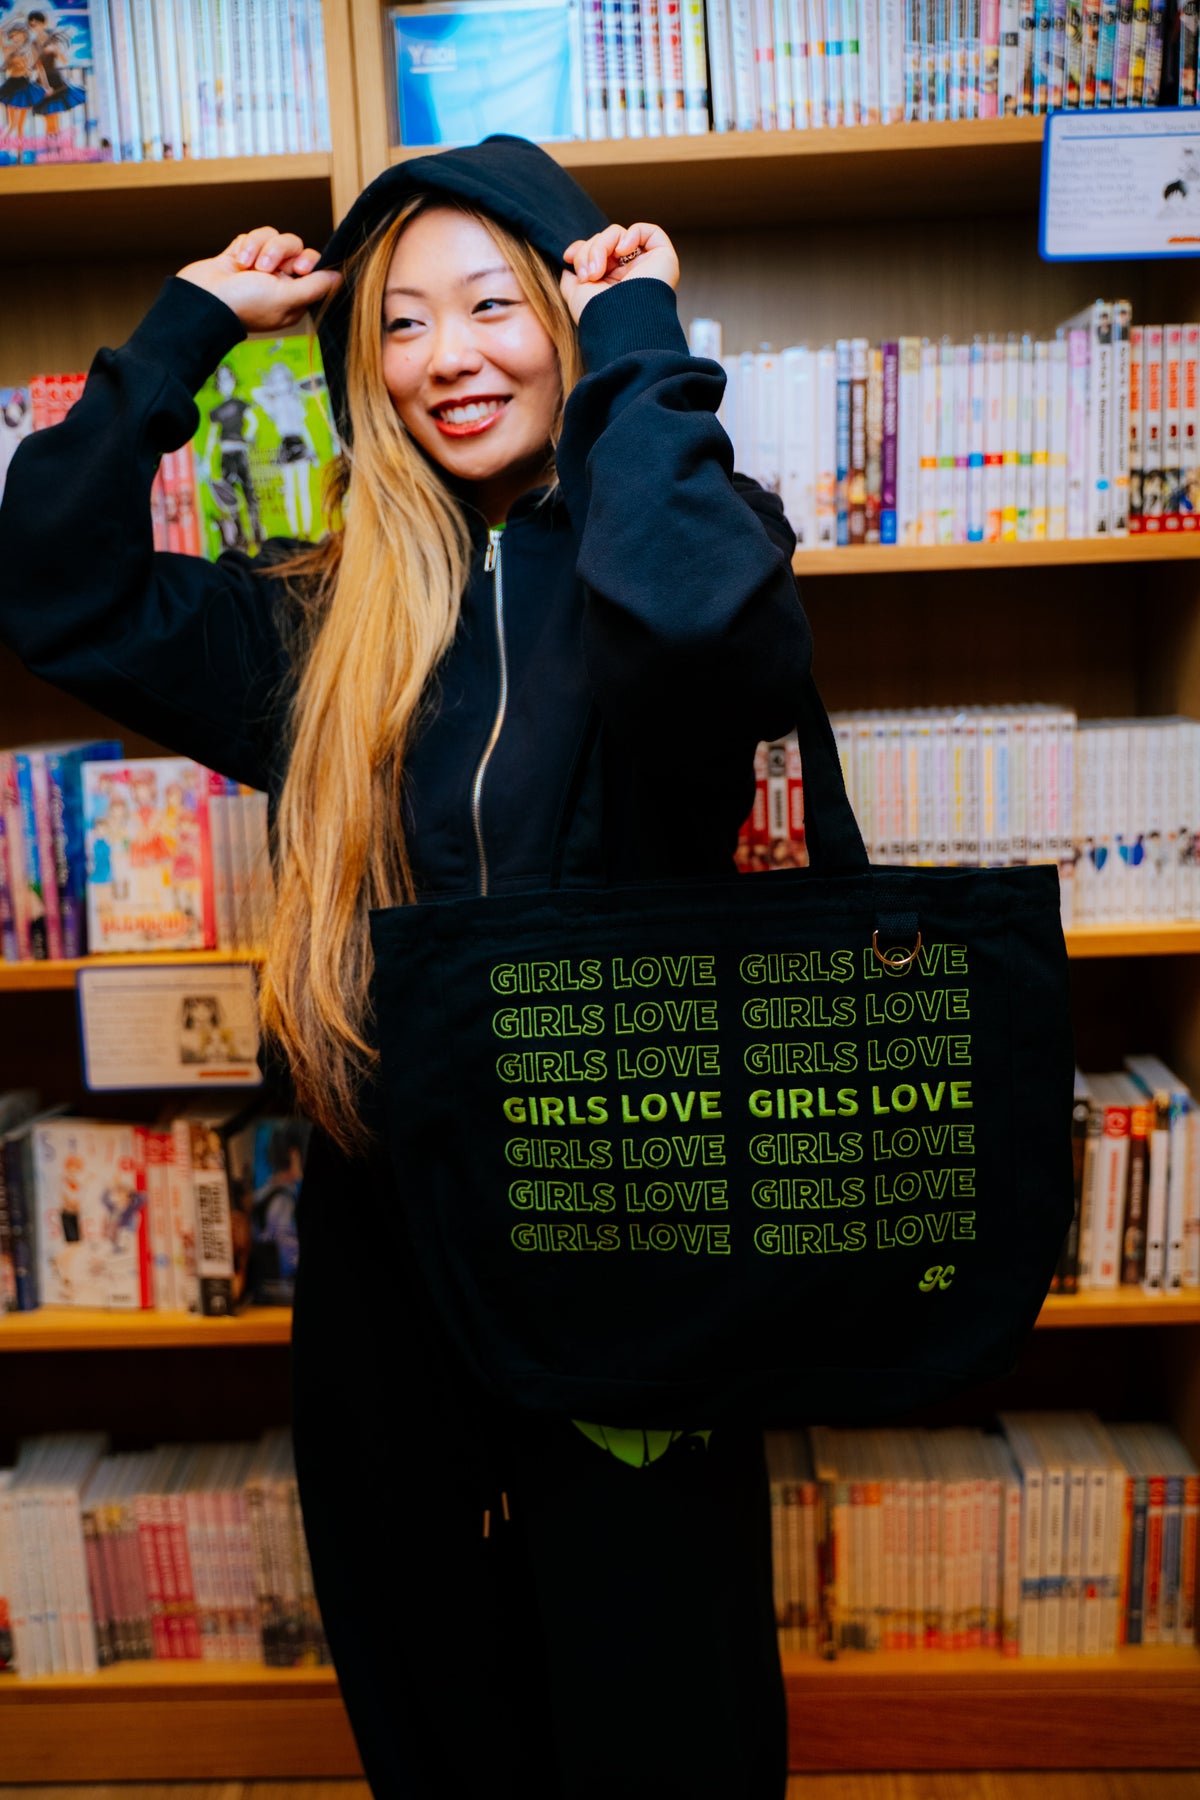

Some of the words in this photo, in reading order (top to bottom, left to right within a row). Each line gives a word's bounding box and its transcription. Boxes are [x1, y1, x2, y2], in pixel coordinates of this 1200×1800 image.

[489, 959, 603, 996] GIRLS
[611, 955, 717, 990] LOVE
[739, 949, 855, 985] GIRLS
[863, 943, 969, 980] LOVE
[491, 1004, 606, 1040] GIRLS
[614, 999, 719, 1035] LOVE
[741, 995, 857, 1030] GIRLS
[865, 988, 971, 1026] LOVE
[495, 1049, 608, 1084] GIRLS
[616, 1044, 721, 1081] LOVE
[743, 1041, 859, 1076] GIRLS
[867, 1034, 972, 1072] LOVE
[502, 1095, 609, 1127] GIRLS
[621, 1090, 723, 1124] LOVE
[747, 1086, 859, 1120] GIRLS
[871, 1080, 974, 1116] LOVE
[504, 1137, 613, 1170] GIRLS
[621, 1134, 727, 1170] LOVE
[748, 1131, 864, 1166] GIRLS
[873, 1124, 976, 1162] LOVE
[508, 1179, 617, 1214] GIRLS
[625, 1179, 729, 1213] LOVE
[751, 1176, 866, 1210] GIRLS
[874, 1167, 976, 1206] LOVE
[510, 1223, 621, 1255] GIRLS
[629, 1223, 731, 1255] LOVE
[753, 1221, 867, 1256] GIRLS
[876, 1210, 977, 1250] LOVE
